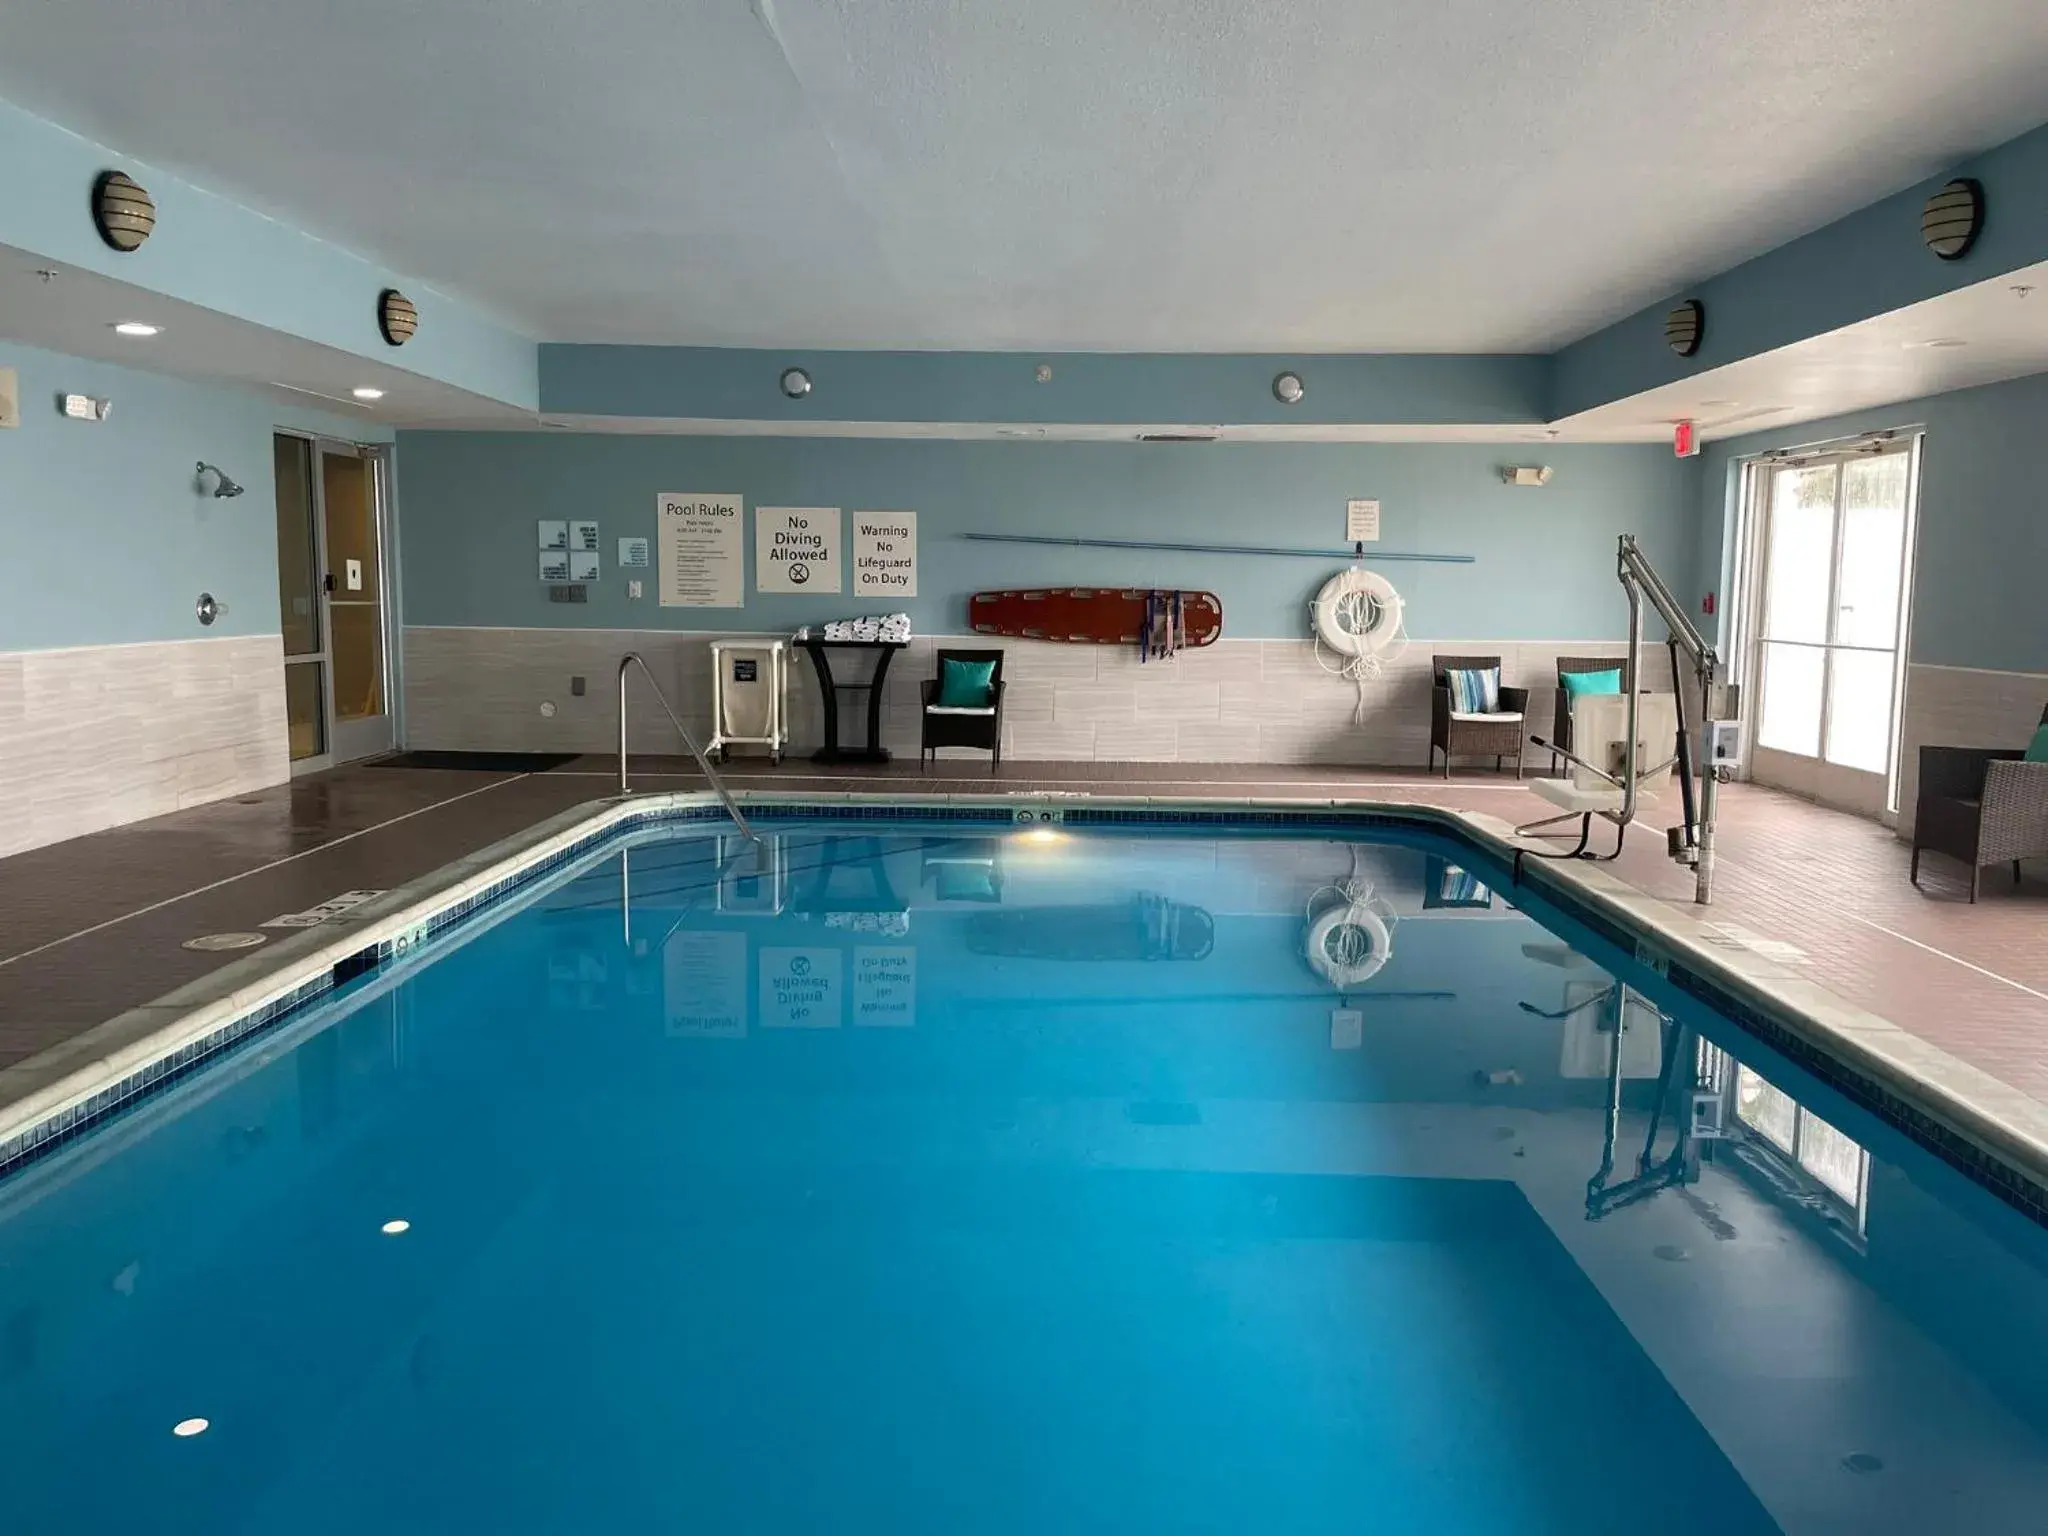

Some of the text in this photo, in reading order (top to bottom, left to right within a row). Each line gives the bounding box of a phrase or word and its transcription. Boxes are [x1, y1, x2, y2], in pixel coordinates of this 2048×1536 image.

[667, 503, 734, 516] Pool Rules
[788, 516, 808, 529] No
[861, 525, 908, 538] Warning
[775, 532, 822, 547] Diving
[877, 542, 893, 552] No
[770, 548, 828, 561] Allowed
[858, 557, 911, 570] Lifeguard
[862, 573, 909, 586] On Duty
